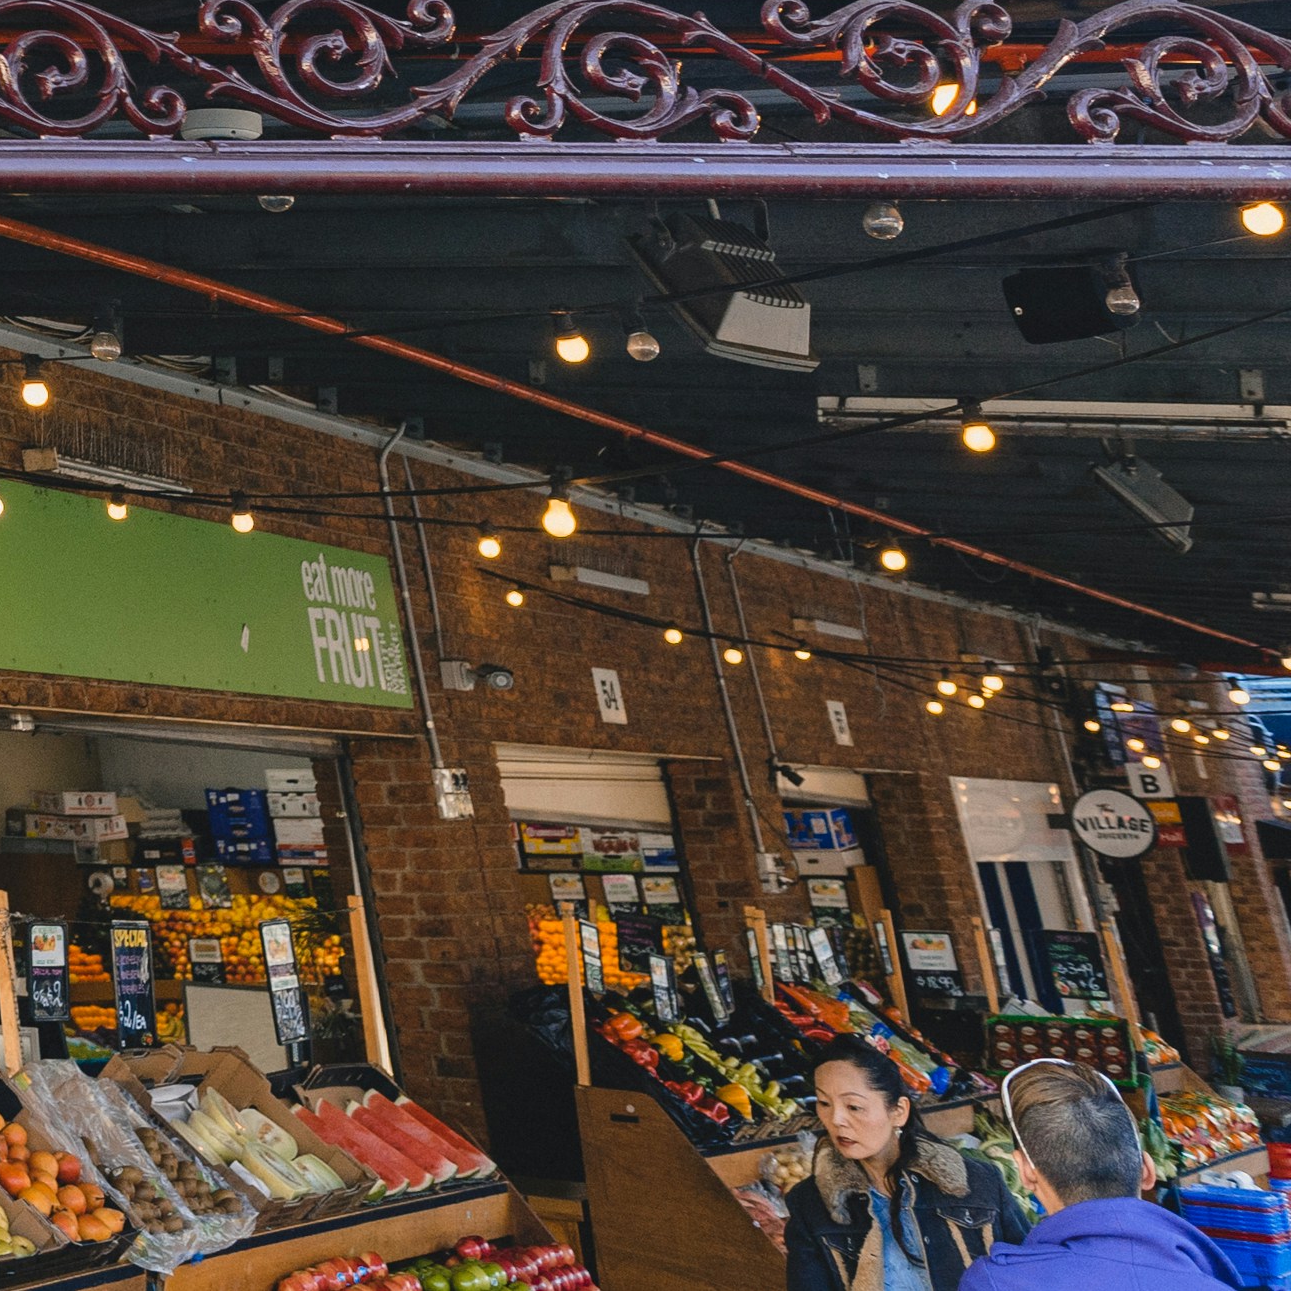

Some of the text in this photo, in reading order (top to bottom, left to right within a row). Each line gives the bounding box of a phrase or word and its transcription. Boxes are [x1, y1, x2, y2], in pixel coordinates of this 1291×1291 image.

[301, 552, 377, 610] eat more
[307, 606, 388, 692] FRUIT
[1139, 774, 1162, 794] B
[1075, 815, 1152, 833] VILLAGE
[114, 929, 149, 948] SPECIAL
